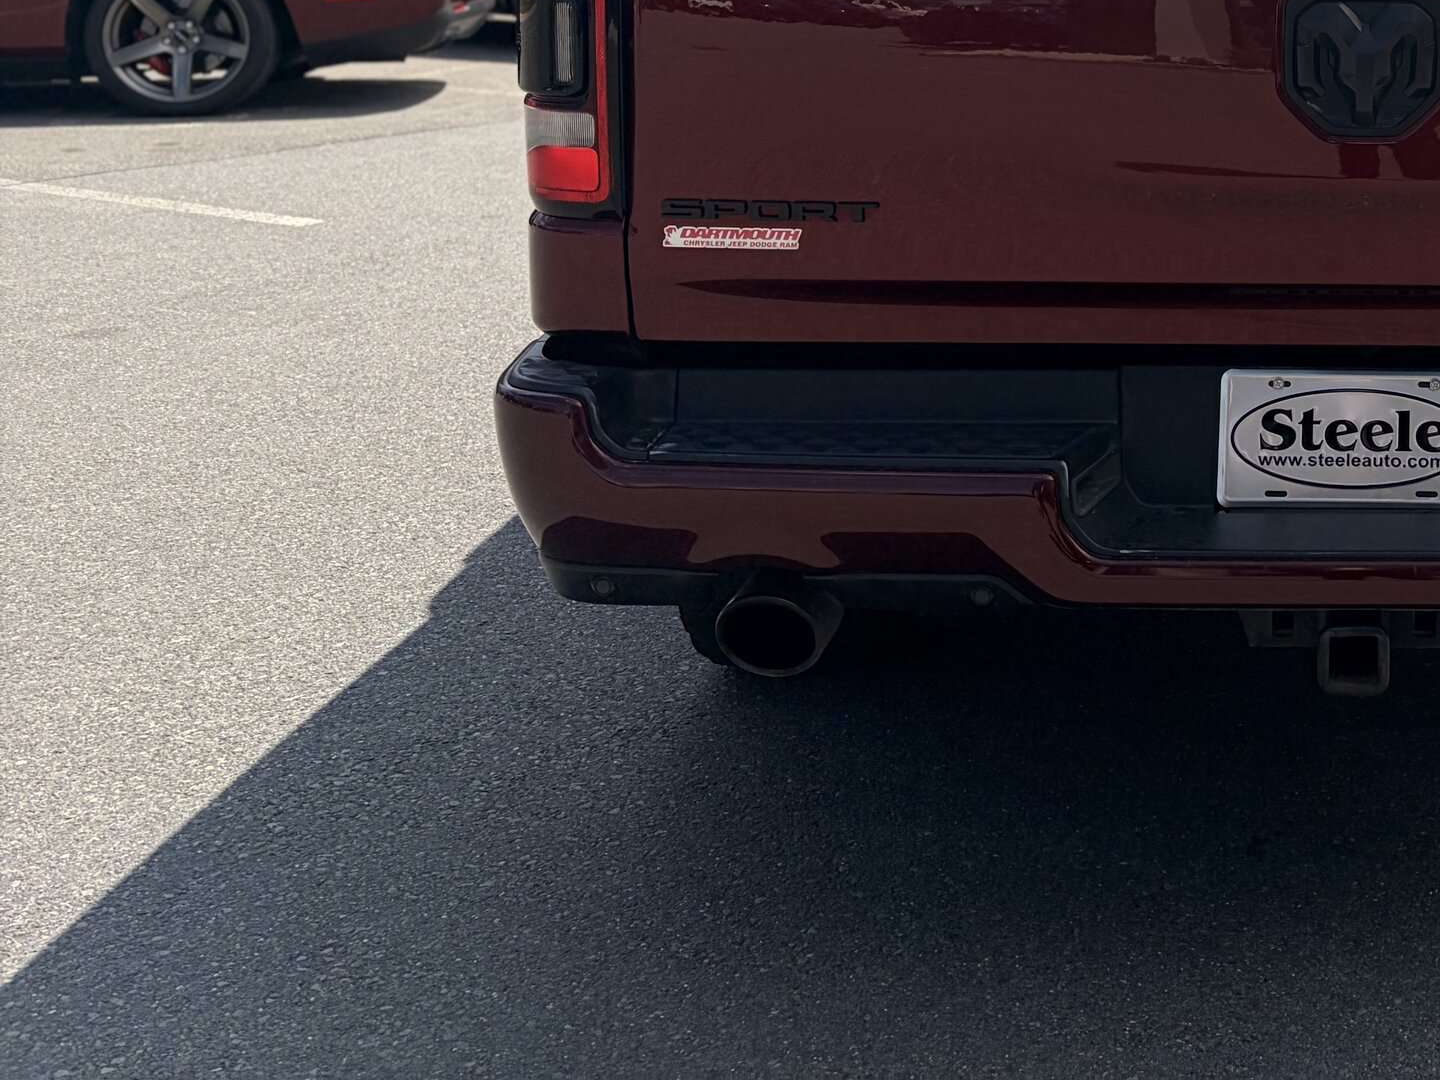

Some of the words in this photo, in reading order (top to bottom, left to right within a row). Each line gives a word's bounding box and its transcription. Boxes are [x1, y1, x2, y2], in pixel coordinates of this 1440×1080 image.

[660, 198, 880, 223] SPORT
[680, 226, 801, 241] DARTMOUTH
[683, 239, 726, 248] CHRYSLER
[727, 240, 748, 248] JEEP
[749, 241, 777, 249] DODGE
[779, 241, 798, 250] RAM
